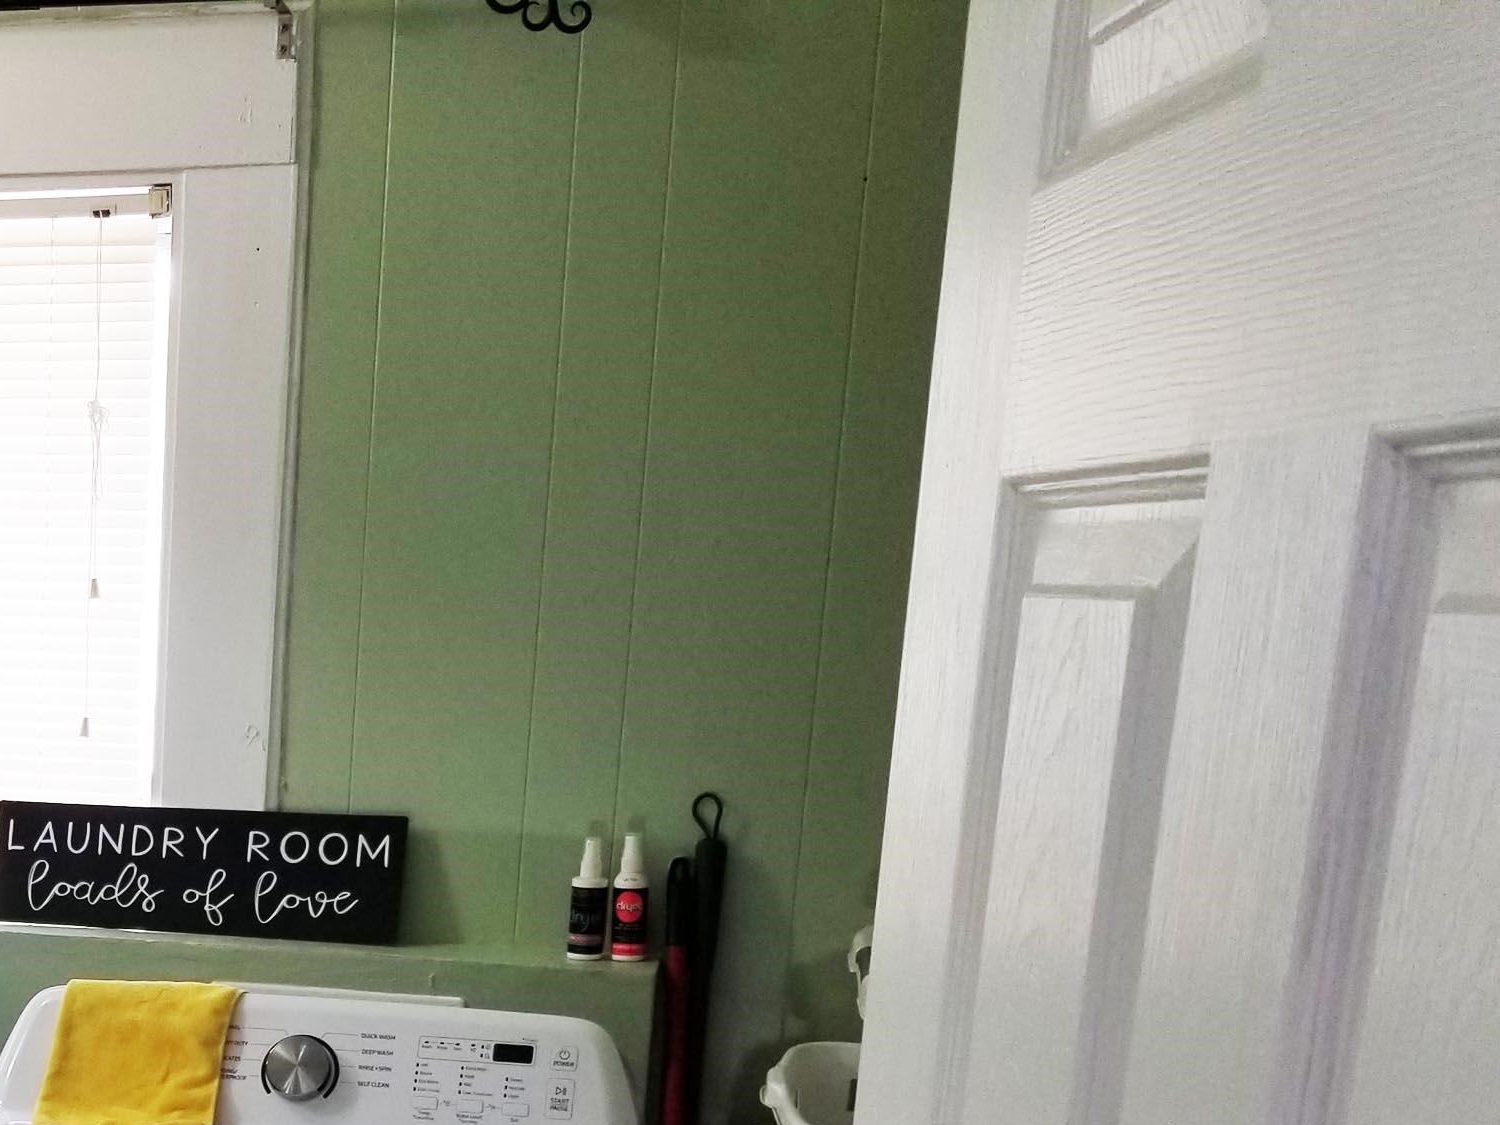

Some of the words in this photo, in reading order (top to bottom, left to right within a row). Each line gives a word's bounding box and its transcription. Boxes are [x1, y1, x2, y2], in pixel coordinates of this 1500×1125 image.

[7, 817, 220, 861] LAUNDRY
[246, 830, 392, 868] ROOM
[26, 859, 165, 913] loads
[182, 868, 235, 926] of
[253, 870, 360, 924] love
